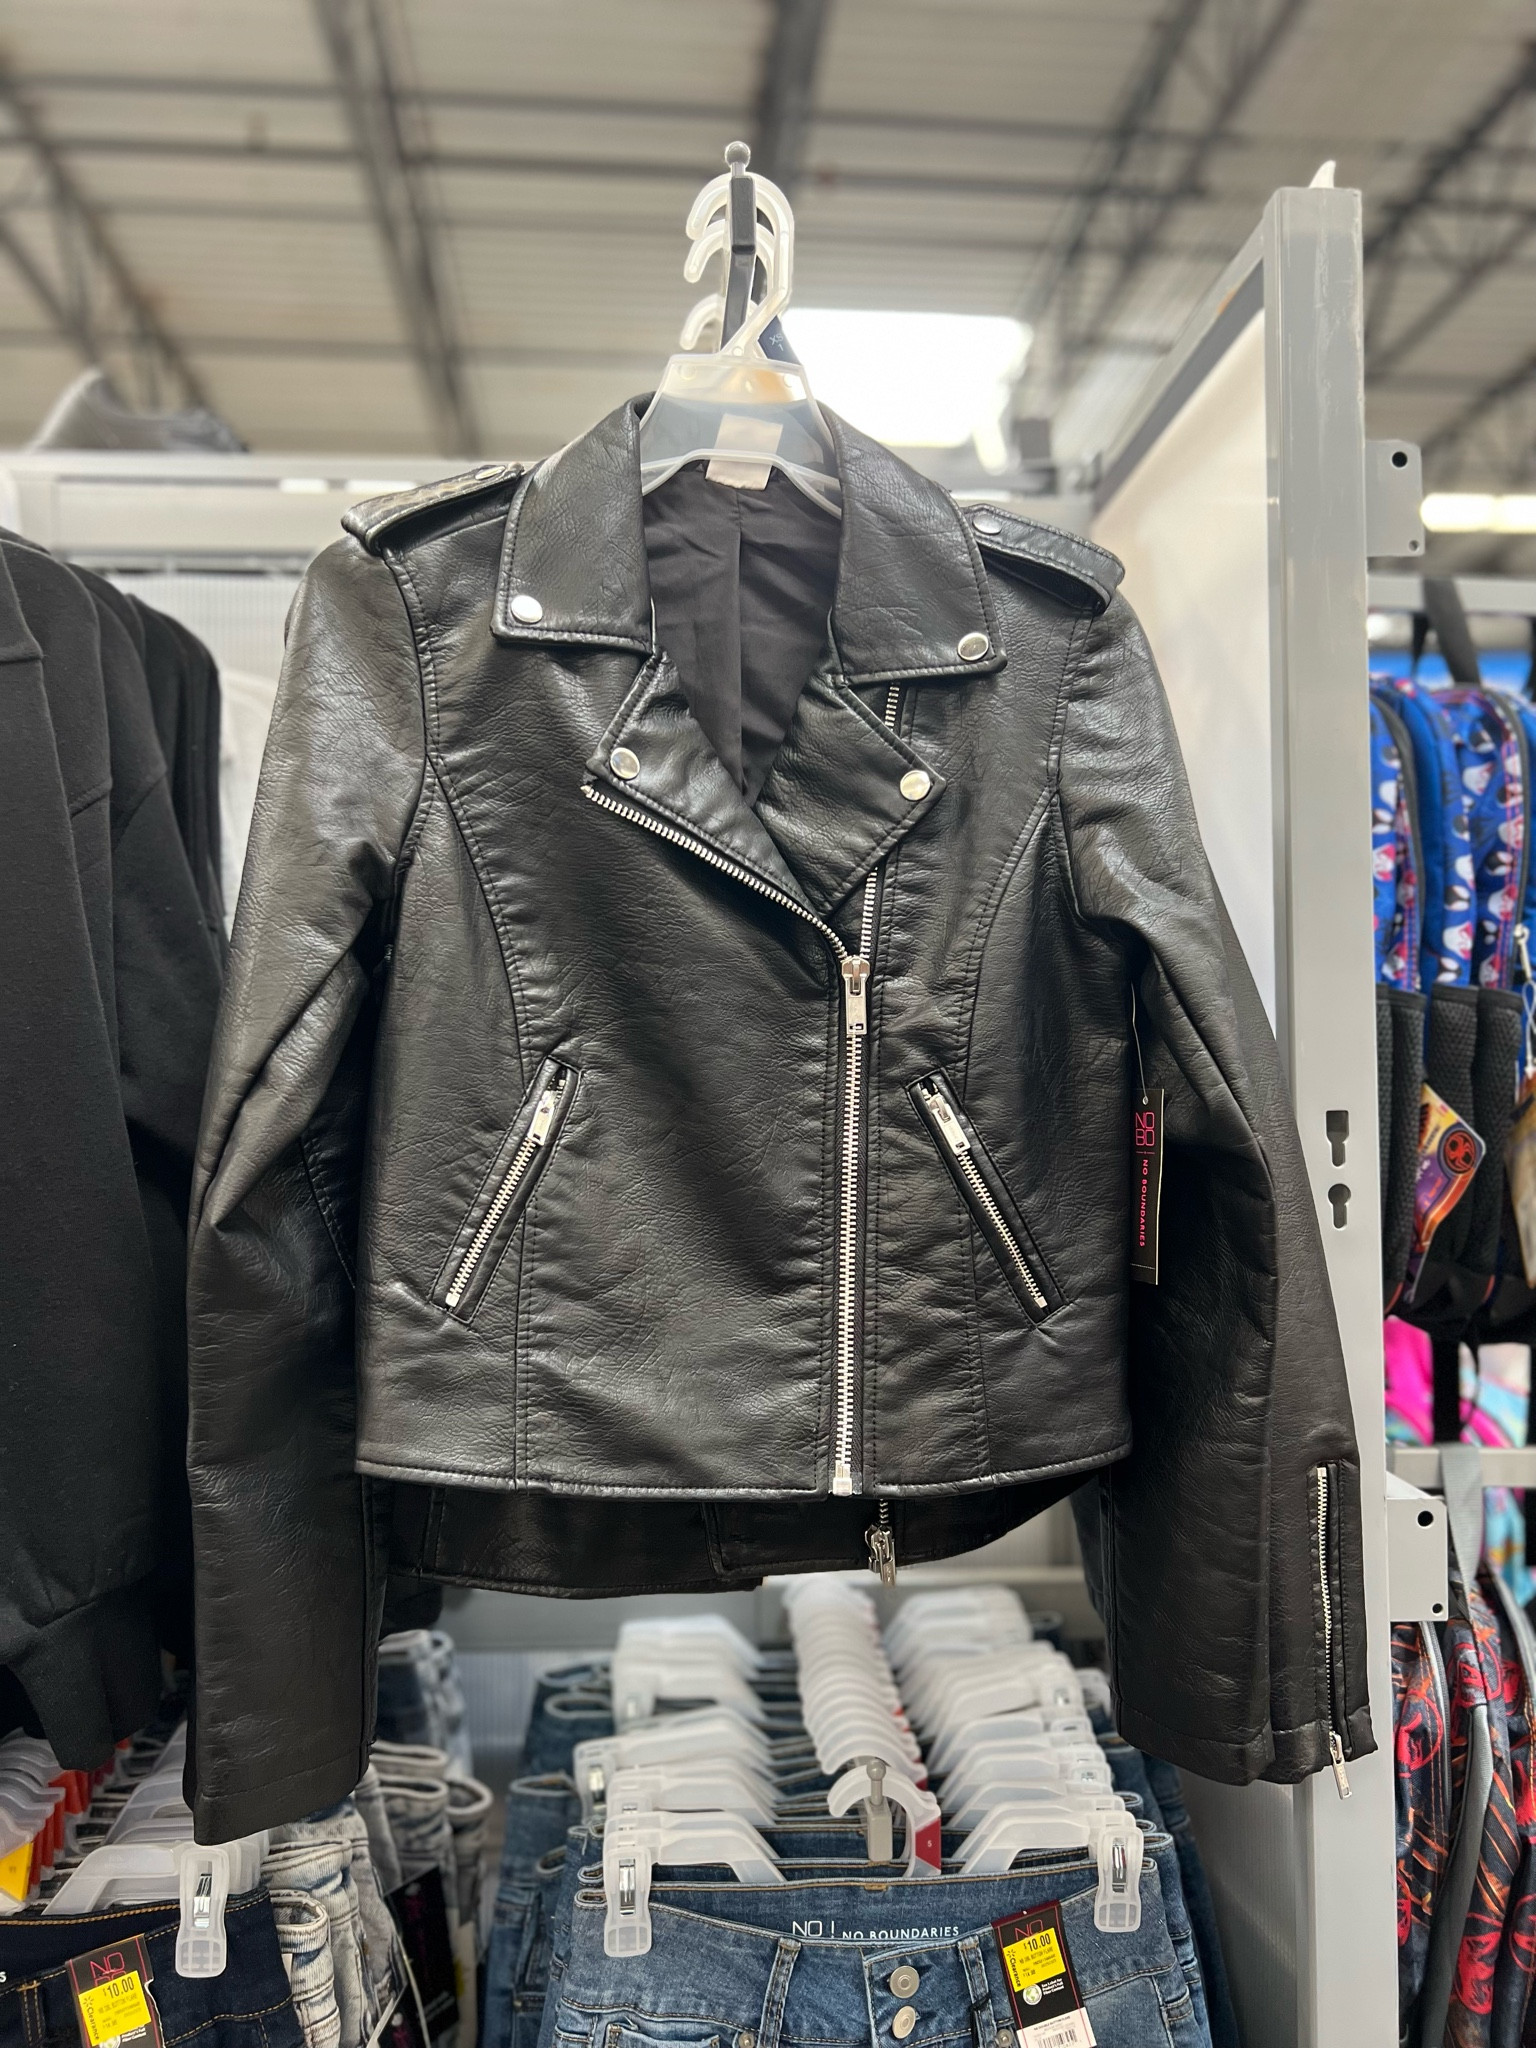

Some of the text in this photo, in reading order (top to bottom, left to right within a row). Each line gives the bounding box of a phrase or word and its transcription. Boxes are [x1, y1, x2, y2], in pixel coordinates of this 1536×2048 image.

[769, 333, 783, 345] XS
[1135, 1111, 1155, 1130] NO
[1135, 1129, 1155, 1146] BO
[1139, 1159, 1148, 1247] NO BOUNDARIES
[927, 1839, 932, 1847] 5
[792, 1920, 959, 1939] NO NO BOUNDARIES
[1014, 1919, 1044, 1941] NO
[1023, 1933, 1051, 1951] $10.00
[90, 1952, 125, 1979] NO
[1009, 1957, 1021, 1987] Clearance
[103, 1976, 135, 1999] $10.00
[86, 2007, 99, 2040] Clearance
